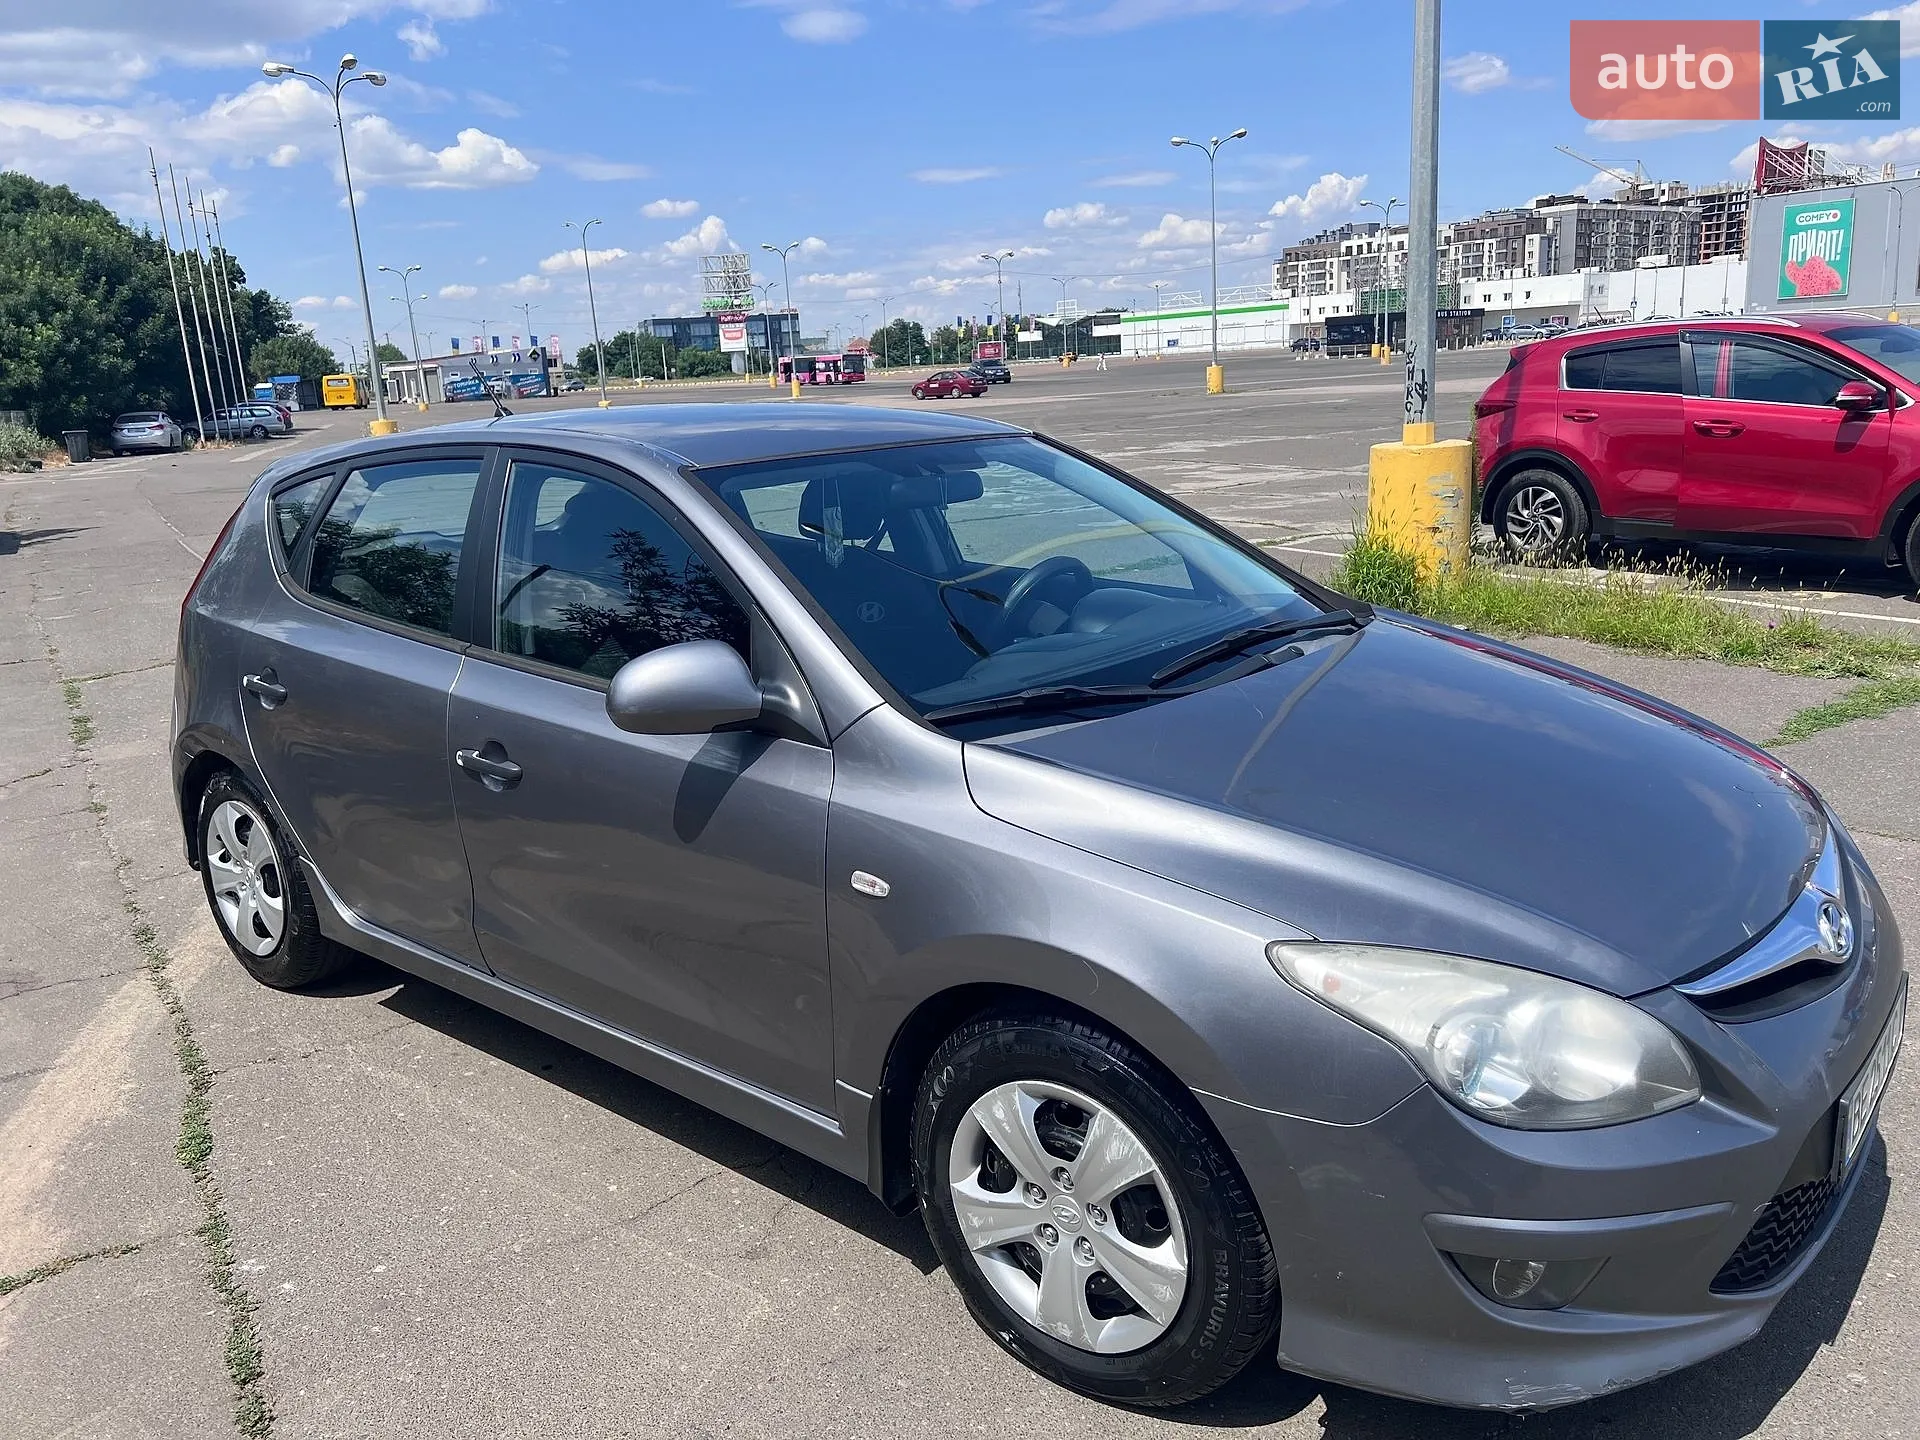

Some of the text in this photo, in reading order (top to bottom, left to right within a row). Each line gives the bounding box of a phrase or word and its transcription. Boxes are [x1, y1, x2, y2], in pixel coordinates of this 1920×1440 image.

[1798, 212, 1832, 223] COMFY
[1788, 228, 1845, 262] ПРИВІТ!
[1200, 1249, 1230, 1350] BRAVURIS
